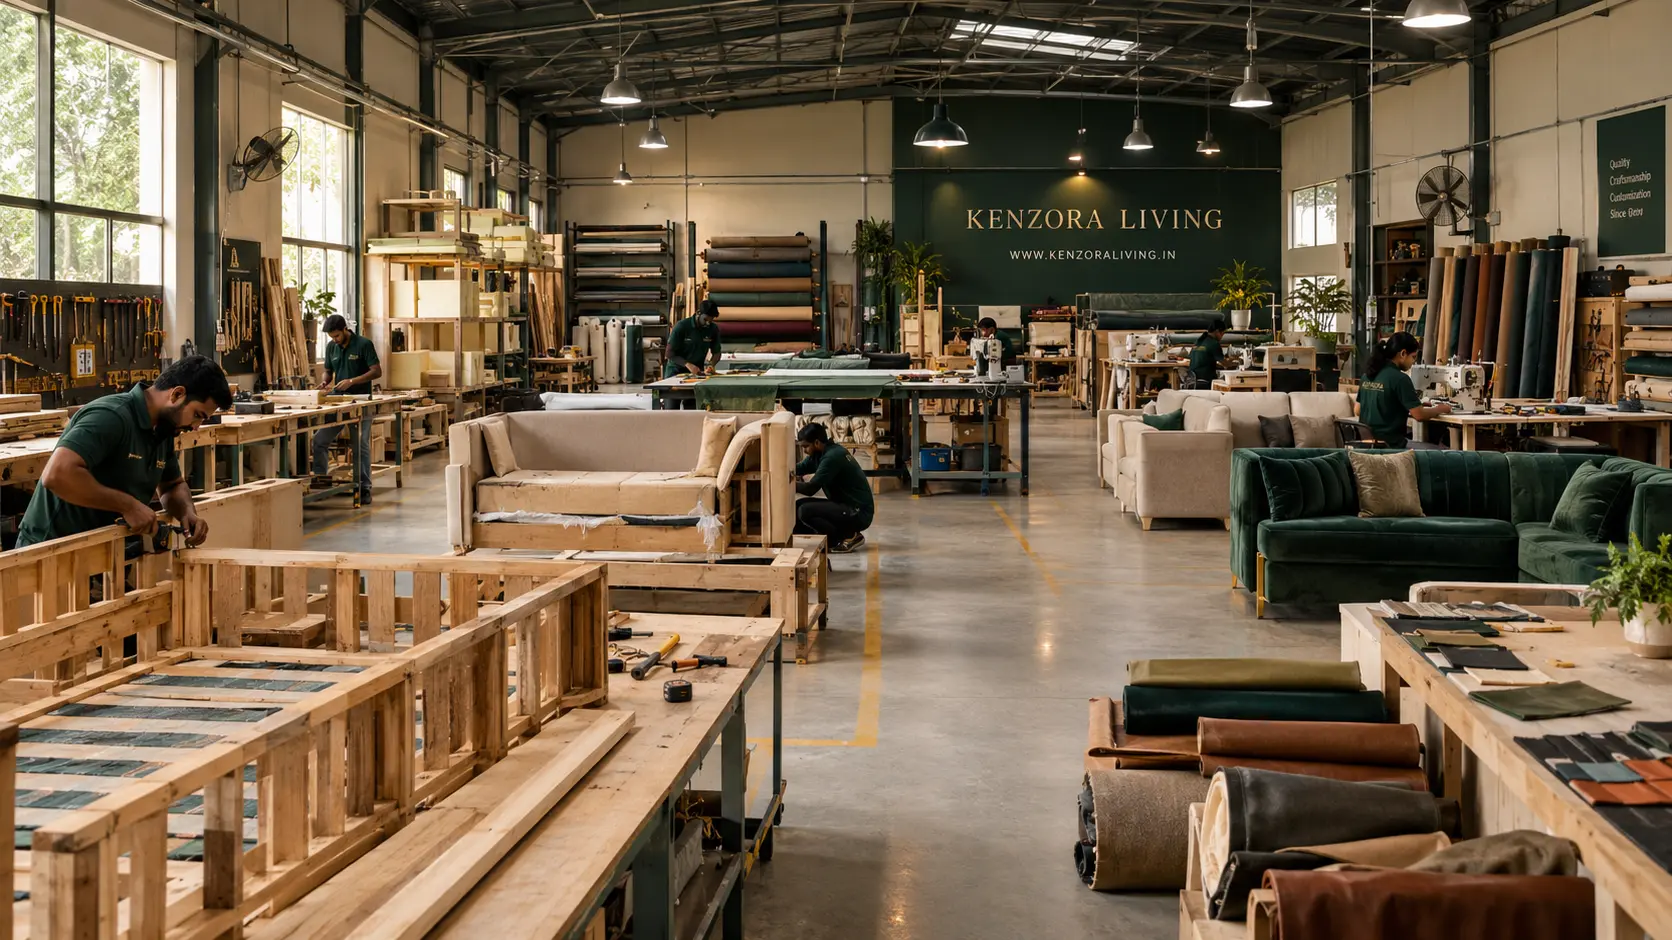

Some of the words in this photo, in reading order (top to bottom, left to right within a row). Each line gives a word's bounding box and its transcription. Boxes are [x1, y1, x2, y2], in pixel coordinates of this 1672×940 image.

[966, 208, 1105, 230] KENZORA
[1119, 208, 1223, 230] LIVING
[1009, 250, 1177, 260] WWW.KENZORALIVING.IN
